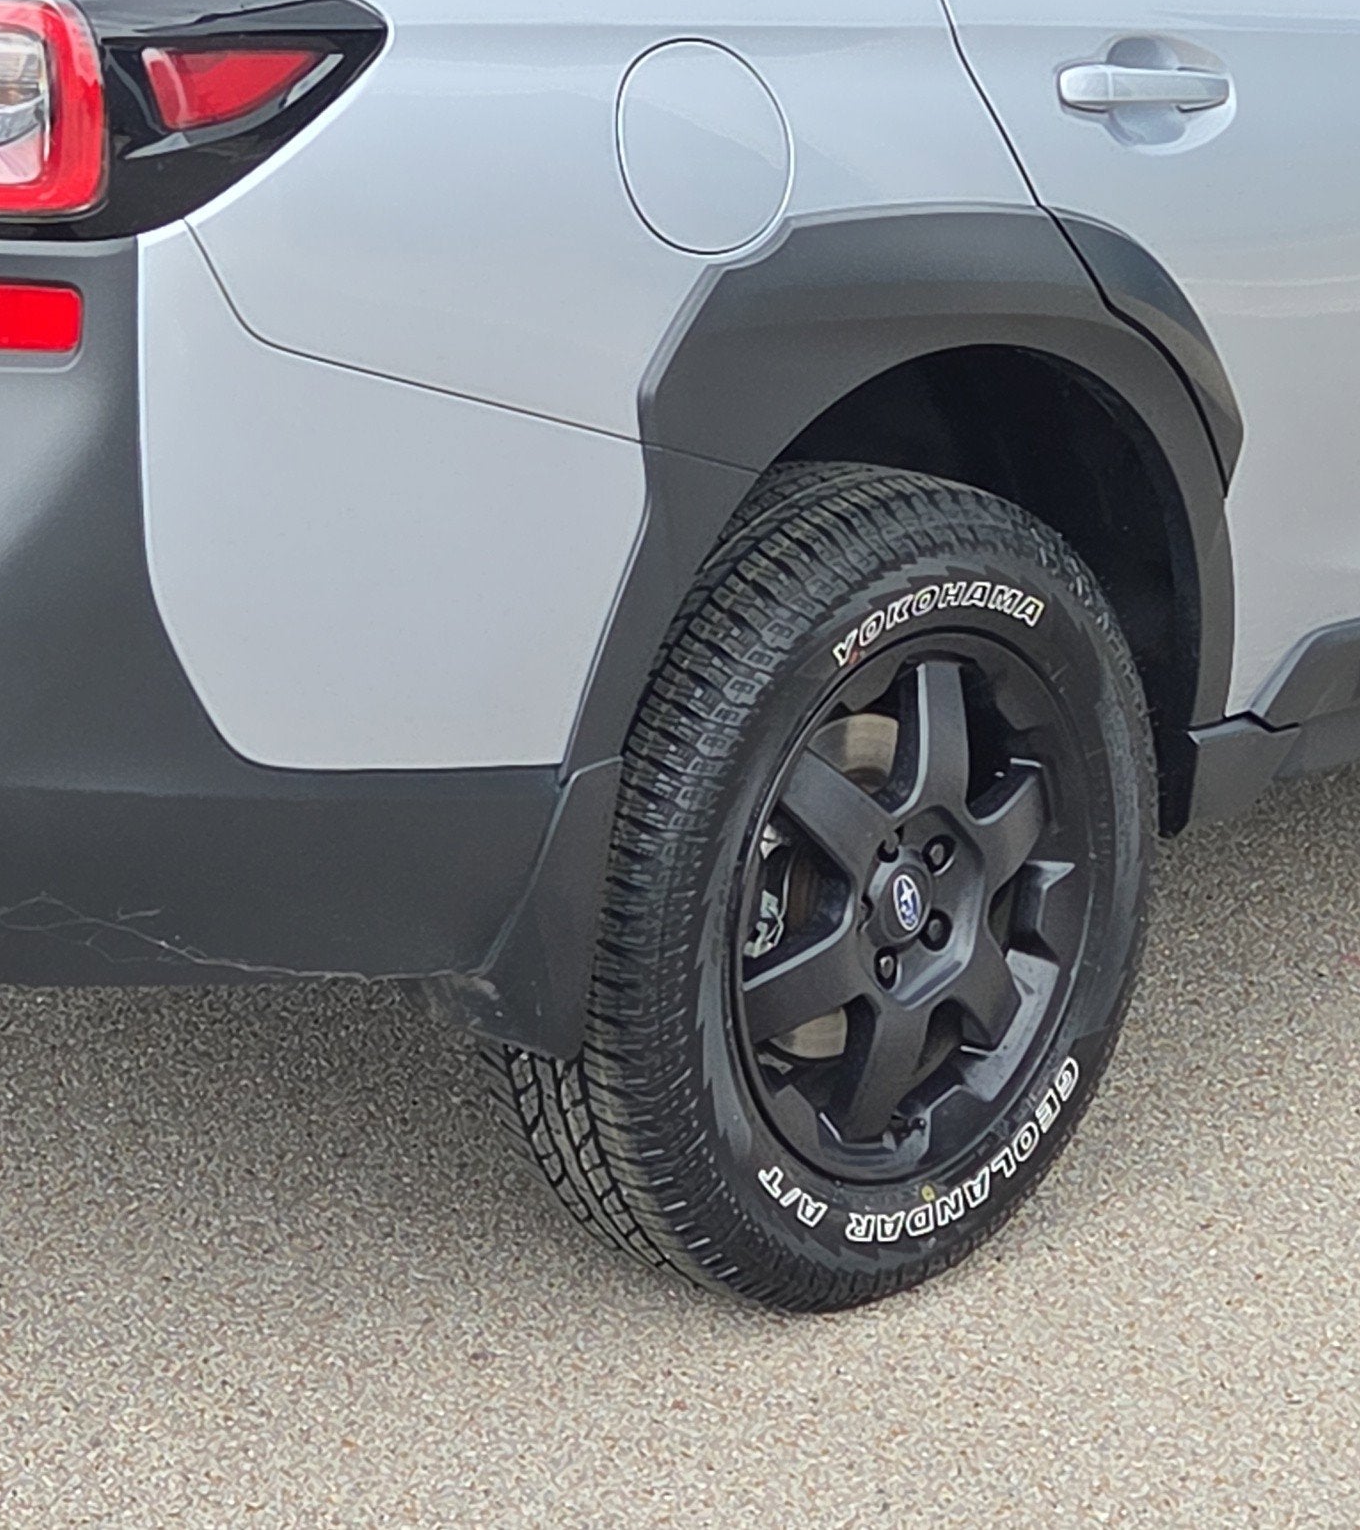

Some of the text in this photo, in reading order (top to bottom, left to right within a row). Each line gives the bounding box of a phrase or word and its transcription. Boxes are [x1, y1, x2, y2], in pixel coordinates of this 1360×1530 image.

[832, 581, 1045, 668] YOKOHAMA
[757, 1056, 1079, 1242] GEOLANDAR A/T
